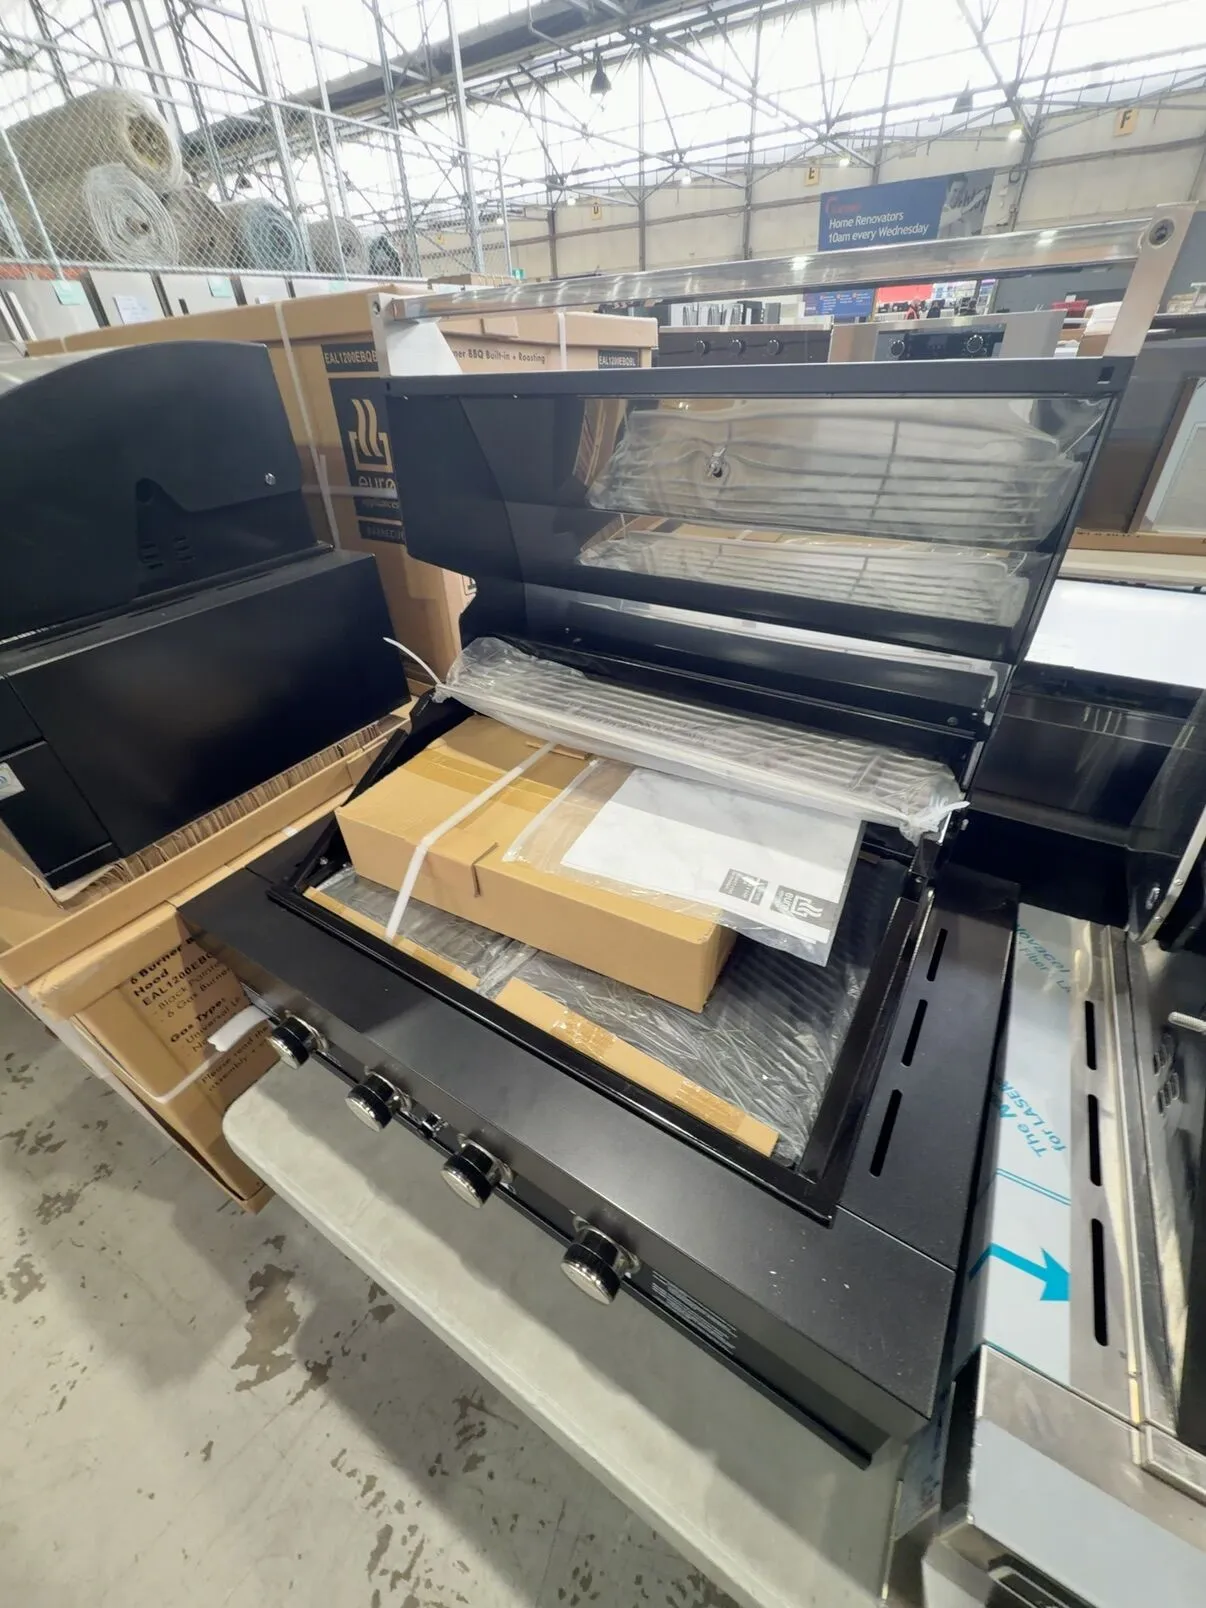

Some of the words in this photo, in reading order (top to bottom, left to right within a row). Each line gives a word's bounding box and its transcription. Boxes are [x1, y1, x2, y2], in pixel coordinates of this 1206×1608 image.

[1120, 110, 1133, 129] F
[829, 216, 857, 229] Home
[855, 211, 904, 226] Renovators
[828, 232, 851, 244] 10am
[851, 229, 877, 241] every
[878, 222, 930, 237] Wednesday
[468, 349, 484, 360] BBQ
[485, 350, 511, 360] Built-in
[518, 352, 546, 364] Roasting
[130, 977, 138, 985] 6
[138, 943, 183, 978] Burner
[170, 1023, 194, 1043] Gas
[1017, 1123, 1047, 1158] The
[1041, 1129, 1067, 1151] for
